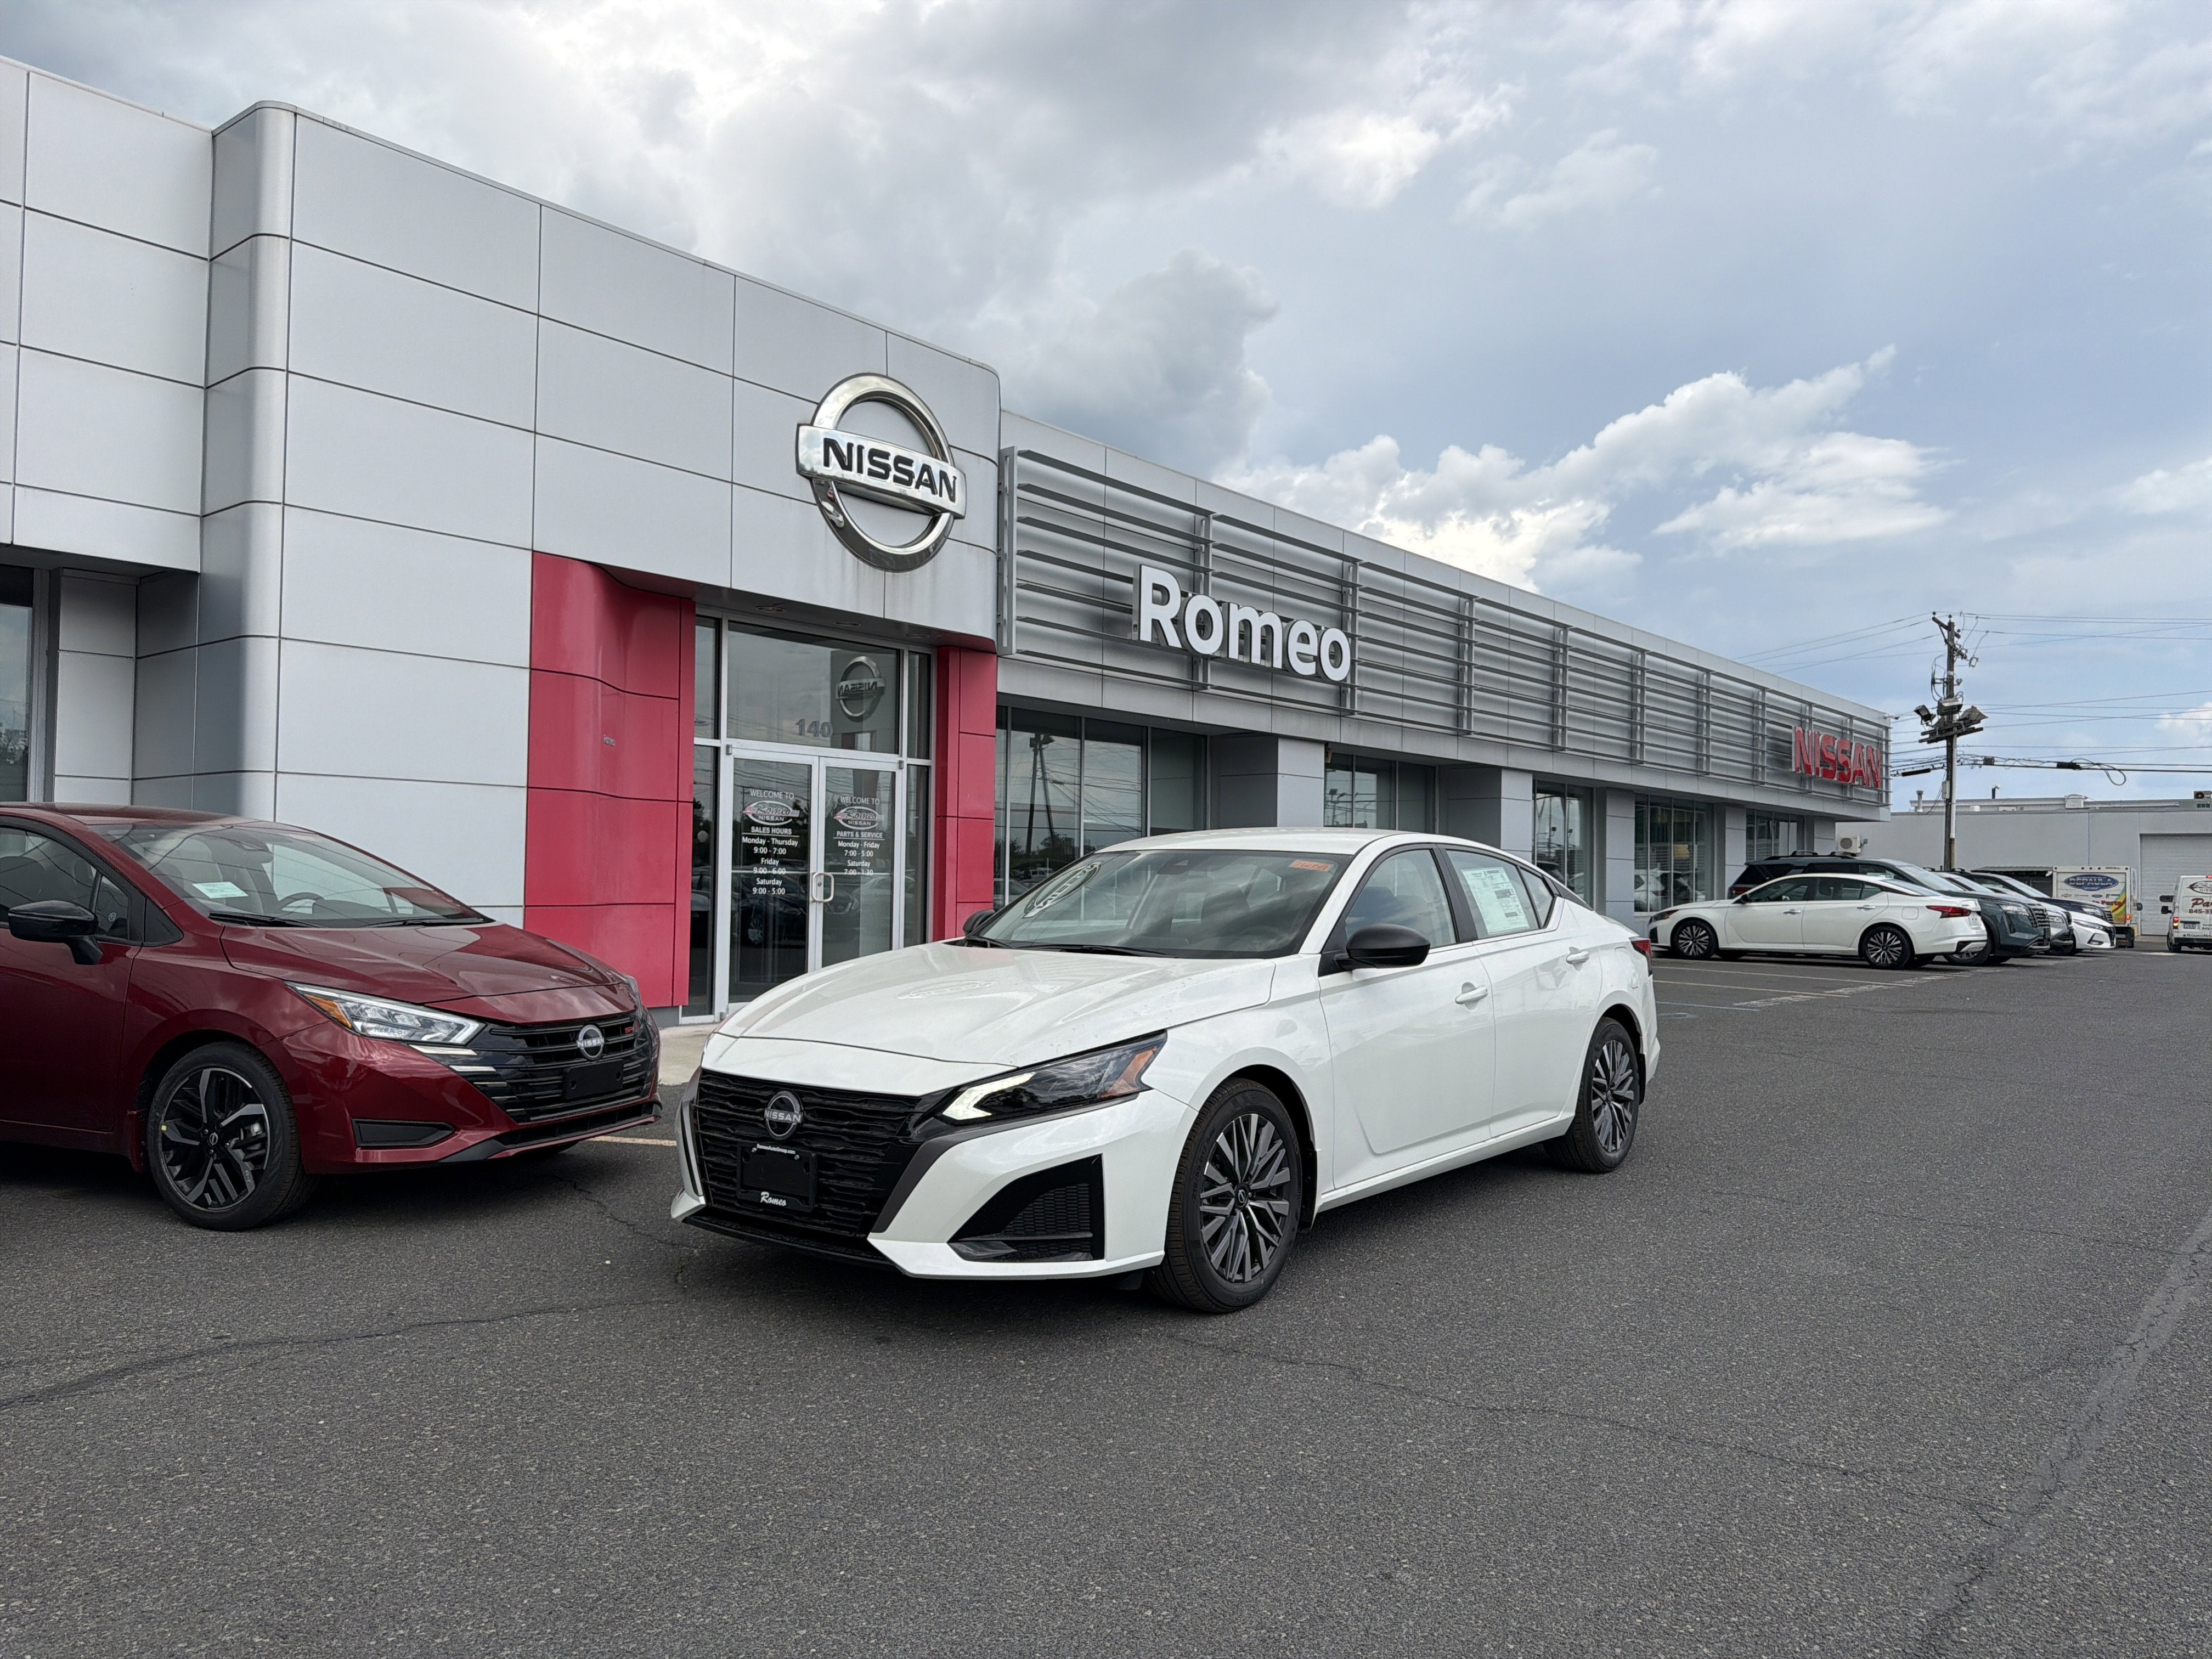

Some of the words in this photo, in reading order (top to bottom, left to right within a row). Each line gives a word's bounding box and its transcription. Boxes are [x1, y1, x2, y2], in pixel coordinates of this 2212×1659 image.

[823, 437, 957, 503] NISSAN
[1136, 564, 1351, 681] Romeo
[795, 719, 833, 738] 140
[1794, 726, 1882, 790] NISSAN
[750, 789, 783, 799] WELCOME
[785, 792, 794, 800] TO
[840, 796, 870, 805] WELCOME
[755, 802, 791, 815] Romeo
[845, 808, 876, 820] Romeo
[742, 836, 766, 845] Monday
[771, 838, 798, 847] Thursday
[838, 840, 860, 849] Monday
[864, 841, 881, 850] Friday
[760, 857, 780, 866] Friday
[847, 859, 871, 868] Saturday
[756, 877, 782, 887] Saturday
[577, 1036, 605, 1048] NISSAN
[764, 1109, 802, 1122] NISSAN
[760, 1192, 787, 1206] Romeo
